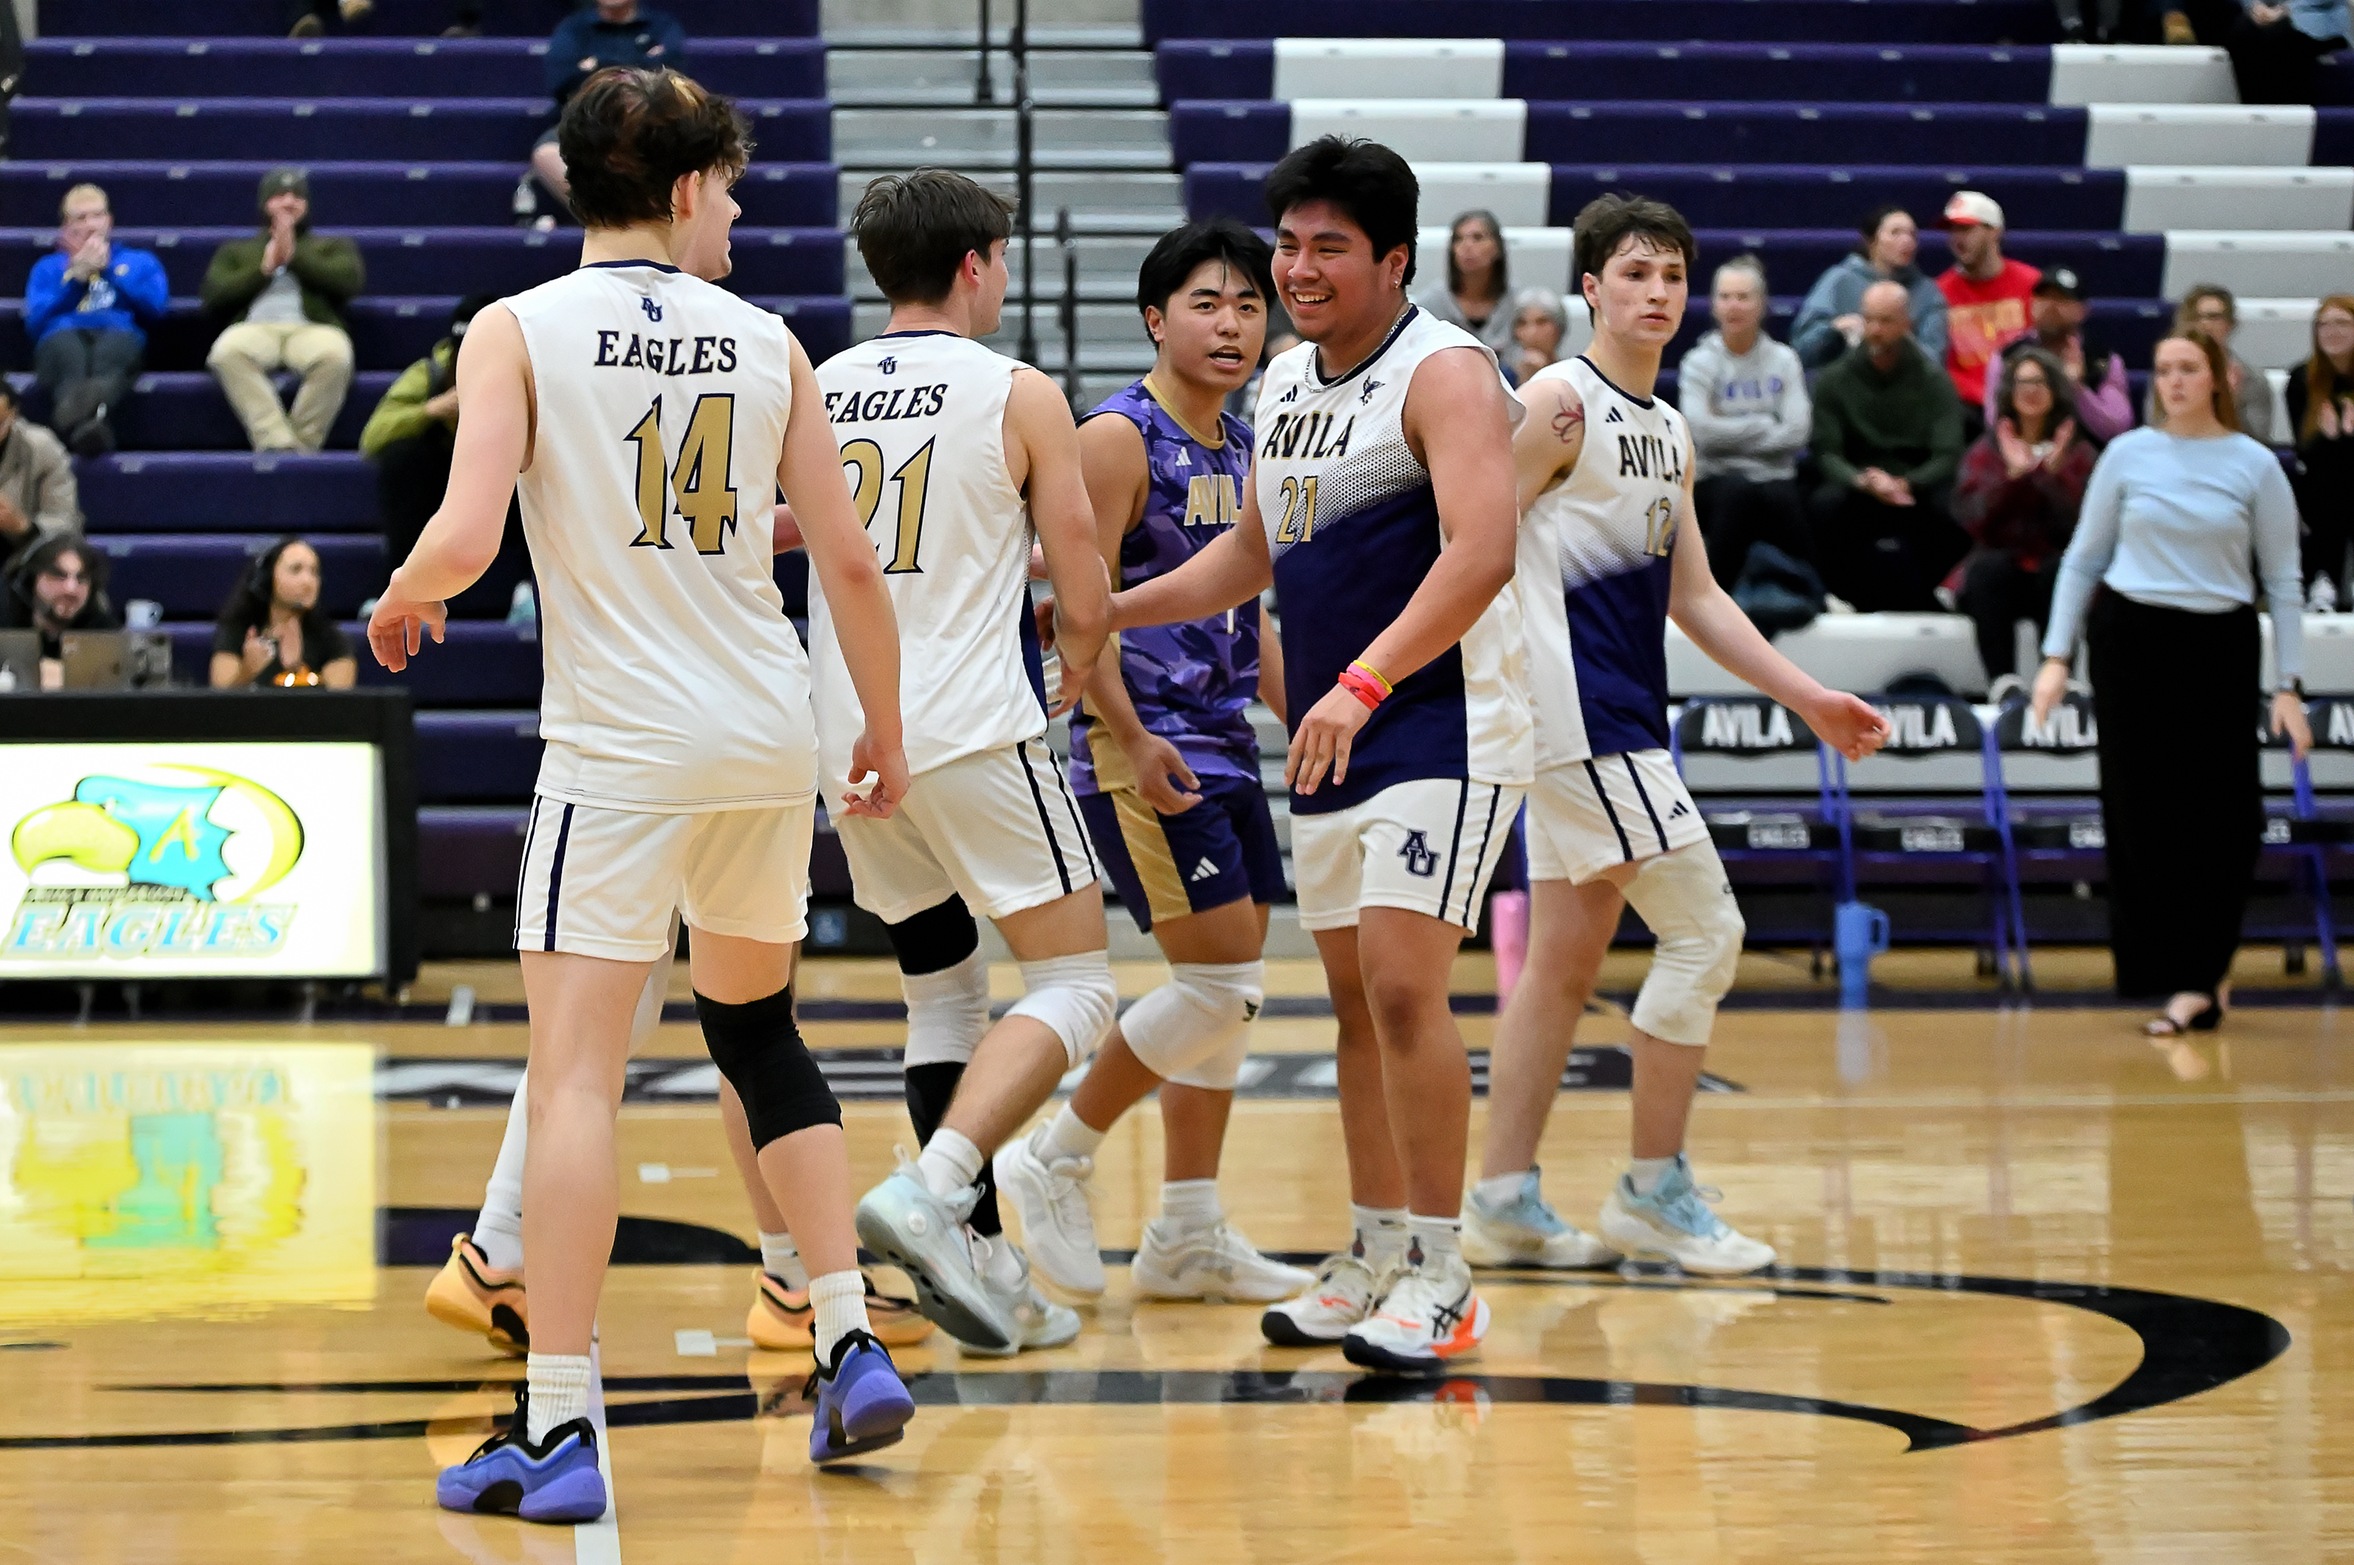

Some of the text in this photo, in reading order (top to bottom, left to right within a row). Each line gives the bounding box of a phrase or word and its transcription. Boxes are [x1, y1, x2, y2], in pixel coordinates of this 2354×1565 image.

[593, 329, 737, 376] EAGLES
[825, 383, 948, 423] EAGLES
[1261, 410, 1356, 460] AVILA
[622, 393, 737, 556] 14
[1184, 473, 1248, 527] AVIL
[1275, 475, 1318, 544] 21
[1701, 703, 1794, 747] AVILA
[1880, 704, 1957, 747] VILA
[1397, 829, 1441, 878] AU
[8, 905, 292, 953] EAGLES
